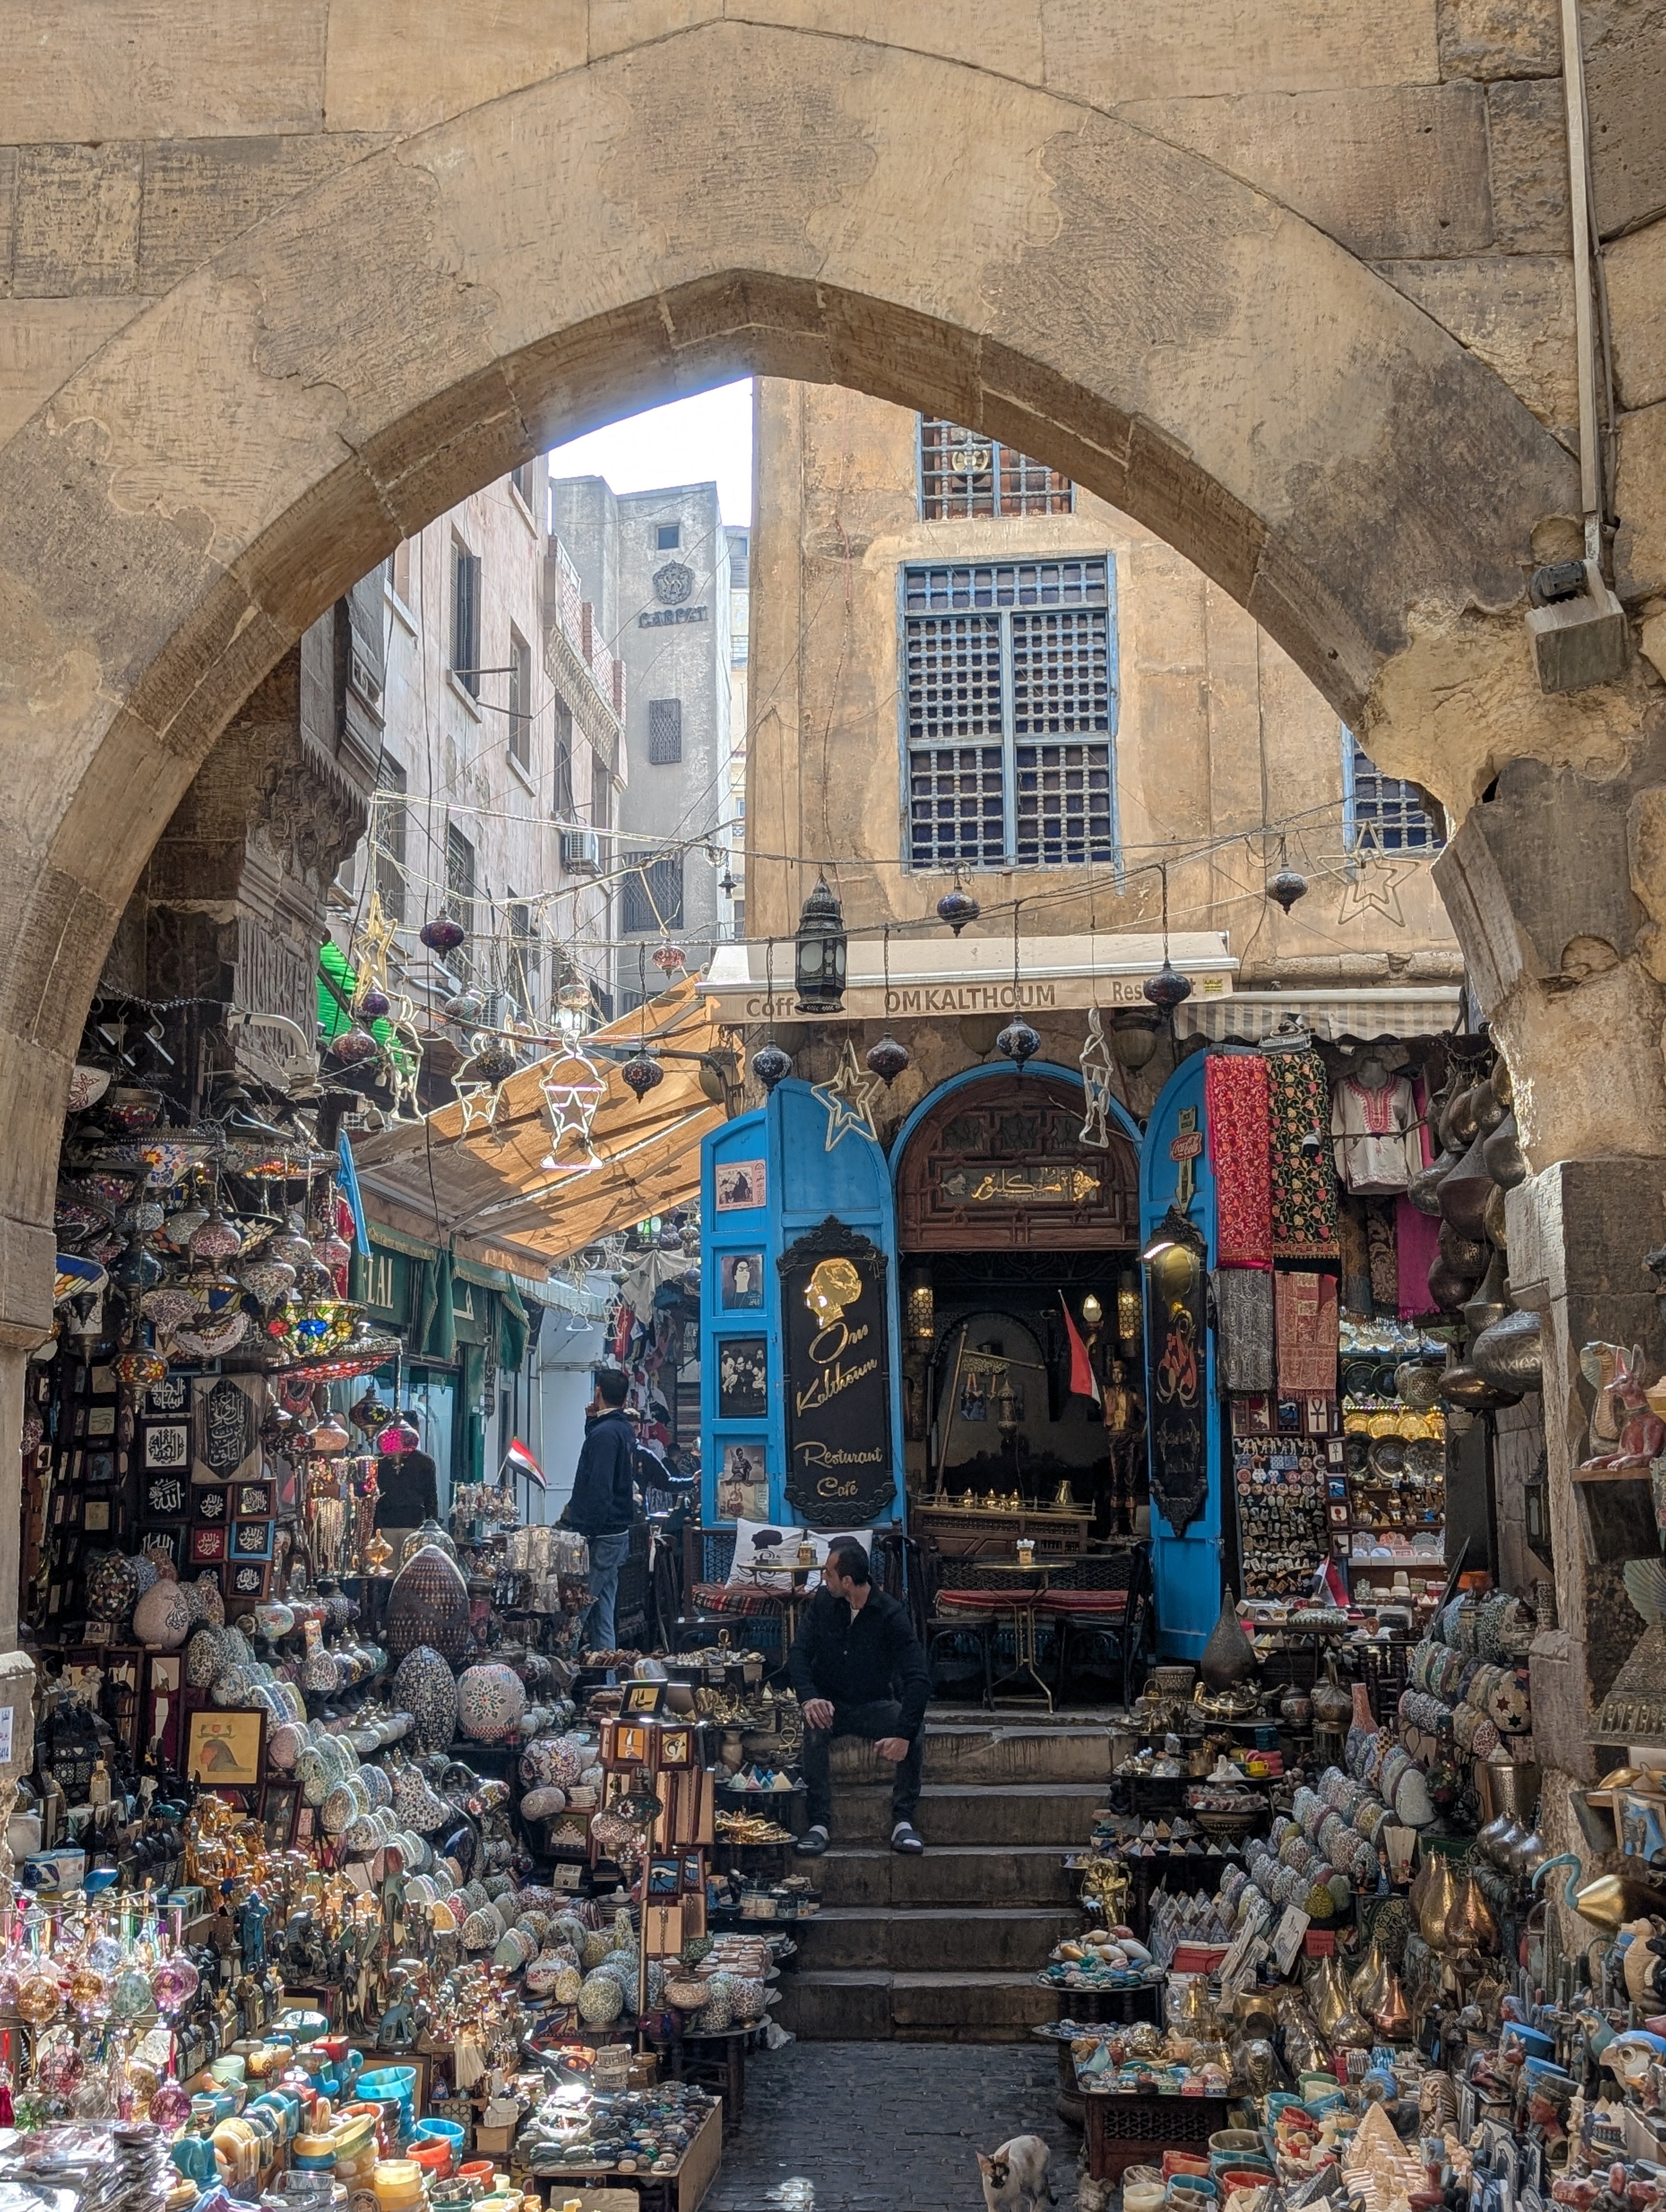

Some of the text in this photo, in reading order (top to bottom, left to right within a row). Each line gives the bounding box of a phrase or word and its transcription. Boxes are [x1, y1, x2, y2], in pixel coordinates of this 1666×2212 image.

[638, 606, 708, 628] CARPET
[746, 996, 808, 1018] Coff
[362, 1252, 394, 1309] LAL
[809, 1322, 868, 1364] Om
[796, 1359, 877, 1417] Kalthoum
[793, 1441, 882, 1468] Resturant
